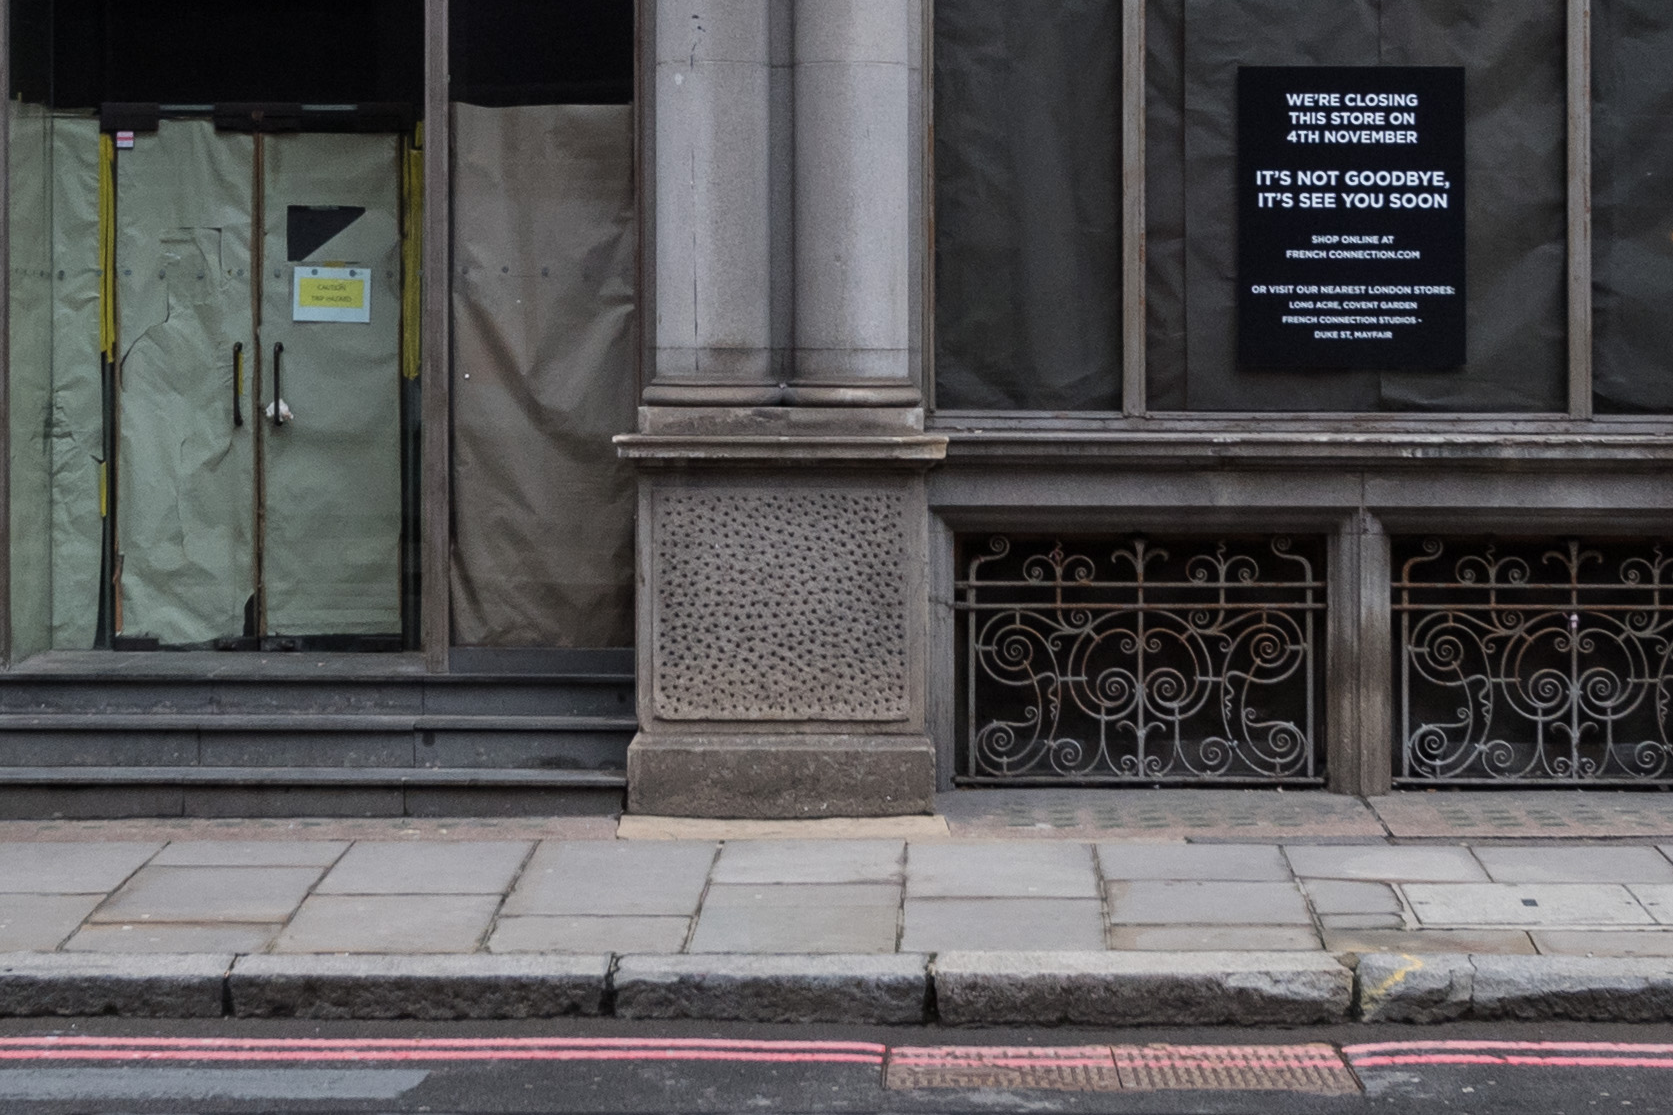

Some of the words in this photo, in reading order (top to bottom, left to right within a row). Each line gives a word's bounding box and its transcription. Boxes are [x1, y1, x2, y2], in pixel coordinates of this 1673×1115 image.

[1286, 93, 1341, 106] WE’RE
[1344, 93, 1418, 107] CLOSING
[1288, 111, 1327, 125] THIS
[1330, 112, 1386, 125] STORE
[1389, 112, 1415, 125] ON
[1286, 130, 1320, 143] 4TH
[1324, 130, 1418, 144] NOVEMBER
[1256, 170, 1292, 186] IT’S
[1297, 170, 1340, 186] NOT
[1344, 170, 1450, 189] GOODBYE,
[1258, 192, 1294, 208] IT’S
[1299, 192, 1336, 208] SEE
[1341, 193, 1384, 208] YOU
[1389, 193, 1448, 209] SOON
[1311, 235, 1340, 244] SHOP
[1341, 235, 1379, 244] ONLINE
[1381, 235, 1395, 244] AT
[1286, 250, 1327, 259] FRENCH
[1328, 250, 1420, 259] CONNECTION.COM
[1251, 285, 1267, 294] OR
[1268, 285, 1295, 294] VISIT
[1296, 285, 1319, 294] OUR
[1320, 285, 1367, 294] NEAREST
[1368, 285, 1412, 295] LONDON
[1413, 285, 1455, 295] STORES:
[1289, 301, 1314, 309] LONG
[1315, 301, 1342, 310] ACRE,
[1342, 301, 1379, 309] COVENT
[1379, 301, 1418, 309] GARDEN
[1282, 315, 1318, 324] FRENCH
[1318, 315, 1378, 324] CONNECTION
[1378, 316, 1417, 324] STUDIOS
[1314, 330, 1339, 339] DUKE
[1340, 330, 1353, 340] ST,
[1354, 331, 1393, 339] MAYFAIR
